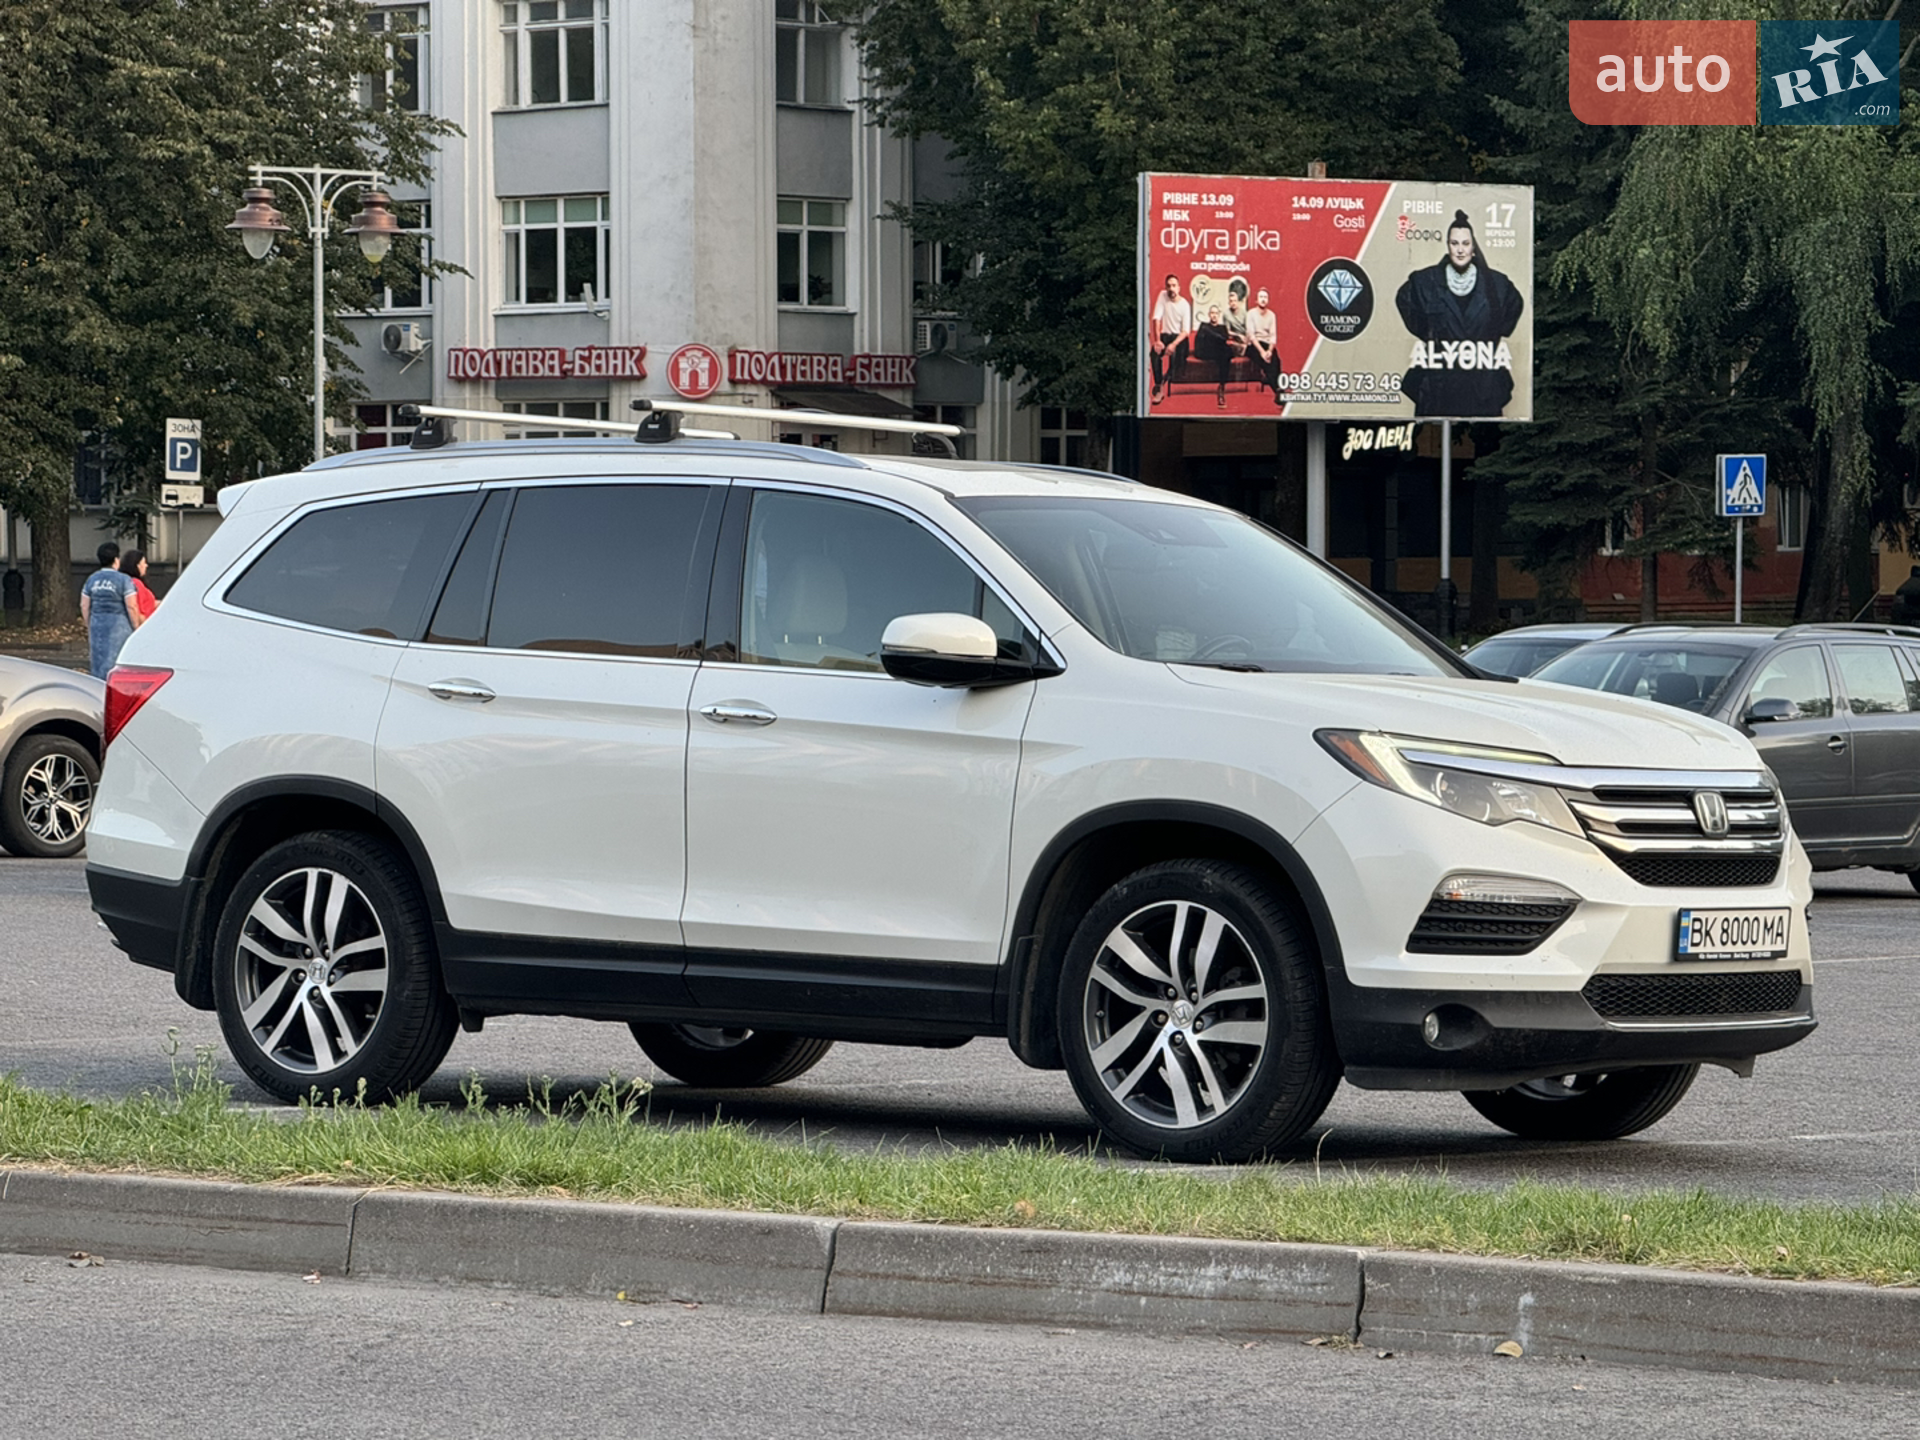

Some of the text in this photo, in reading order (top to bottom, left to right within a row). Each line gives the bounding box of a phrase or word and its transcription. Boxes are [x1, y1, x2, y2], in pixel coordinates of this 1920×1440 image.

[1162, 191, 1234, 206] РІВНЕ 13.09
[1291, 195, 1365, 211] 14.09 ЛУЦЬК
[1402, 200, 1444, 214] РІВНЕ
[1162, 209, 1190, 222] МБК
[1333, 213, 1365, 228] Gosti
[1484, 202, 1516, 228] 17
[1320, 314, 1361, 325] DIAMOND
[1324, 324, 1356, 333] CONCERT
[447, 346, 646, 378] ПОЛТАВА-БАНК
[734, 350, 917, 385] ПОЛТАВА-БАНК
[1277, 372, 1402, 391] 098 445 73 46
[1313, 393, 1328, 402] ТУТ
[171, 423, 196, 433] ЗОНА
[1342, 422, 1416, 461] ЗОО ЛЕНД
[176, 441, 192, 469] P
[1690, 915, 1784, 947] BK 8000 MA
